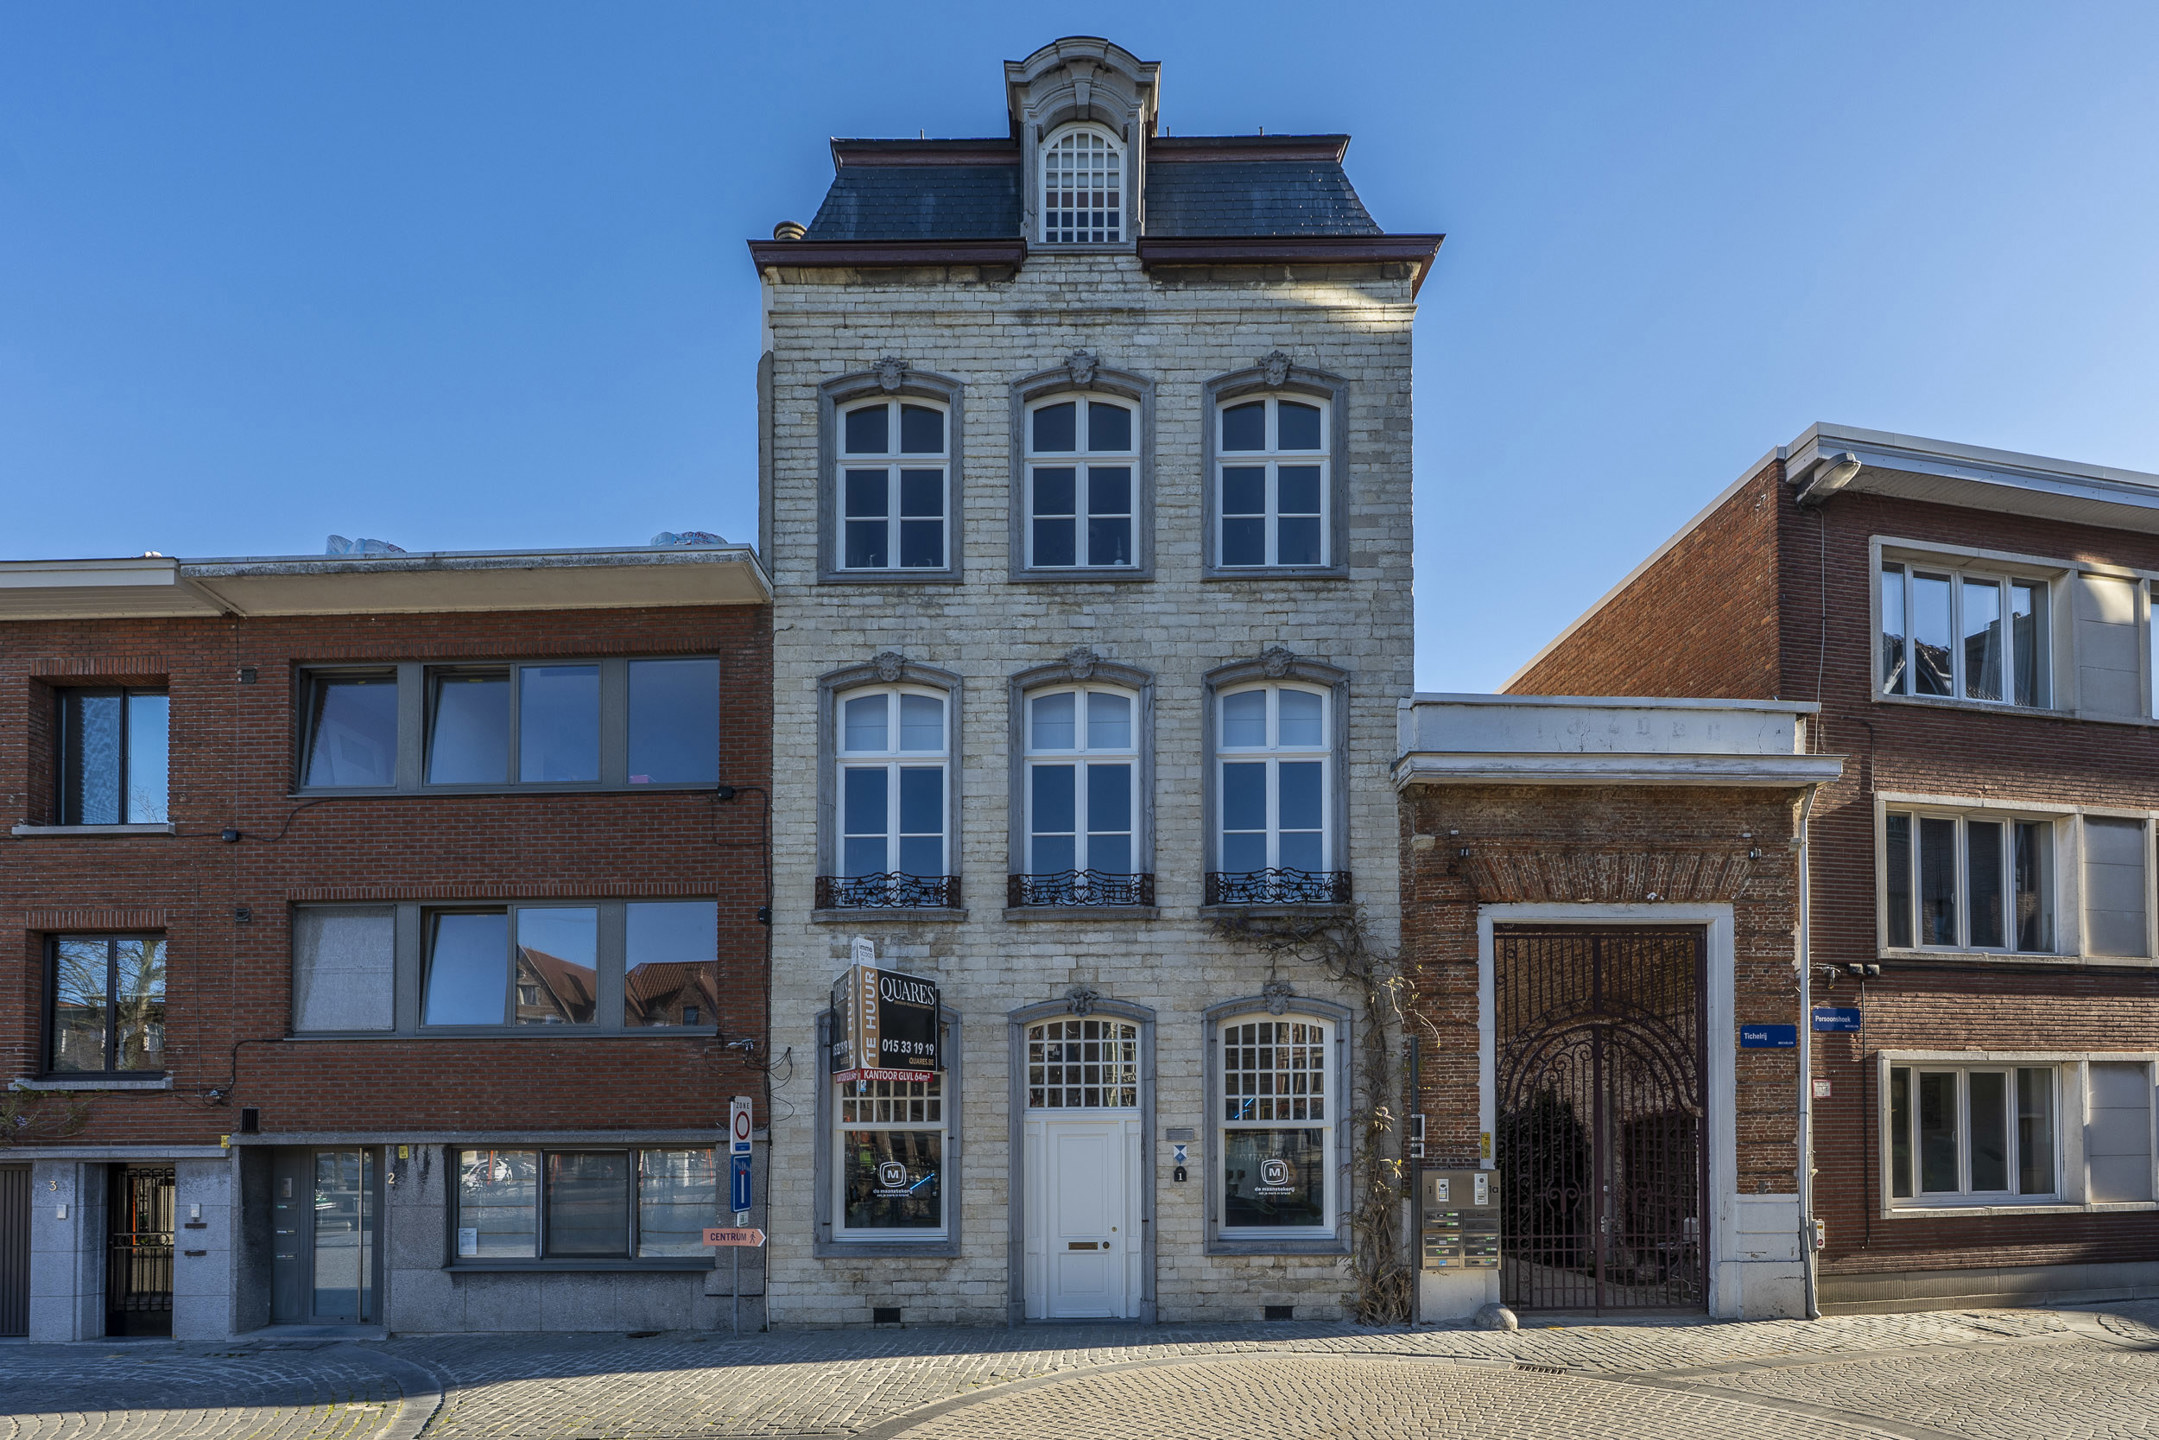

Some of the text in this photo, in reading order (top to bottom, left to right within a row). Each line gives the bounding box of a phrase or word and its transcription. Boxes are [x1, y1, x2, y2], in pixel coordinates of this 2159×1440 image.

[880, 976, 935, 1006] QUARES
[864, 971, 877, 1061] TE HUUR
[1815, 1015, 1851, 1023] Persoonshoek
[1744, 1032, 1767, 1041] Tichelrij
[882, 1038, 935, 1056] 015 33 19 19
[863, 1069, 898, 1080] KANTOOR
[898, 1071, 914, 1081] GLVL
[736, 1101, 750, 1110] ZONE
[887, 1169, 899, 1179] M
[1178, 1172, 1183, 1181] 1
[1268, 1167, 1281, 1177] M
[387, 1172, 396, 1185] 2
[48, 1180, 58, 1192] 3
[1489, 1185, 1499, 1194] 1a
[710, 1232, 747, 1242] CENTRUM
